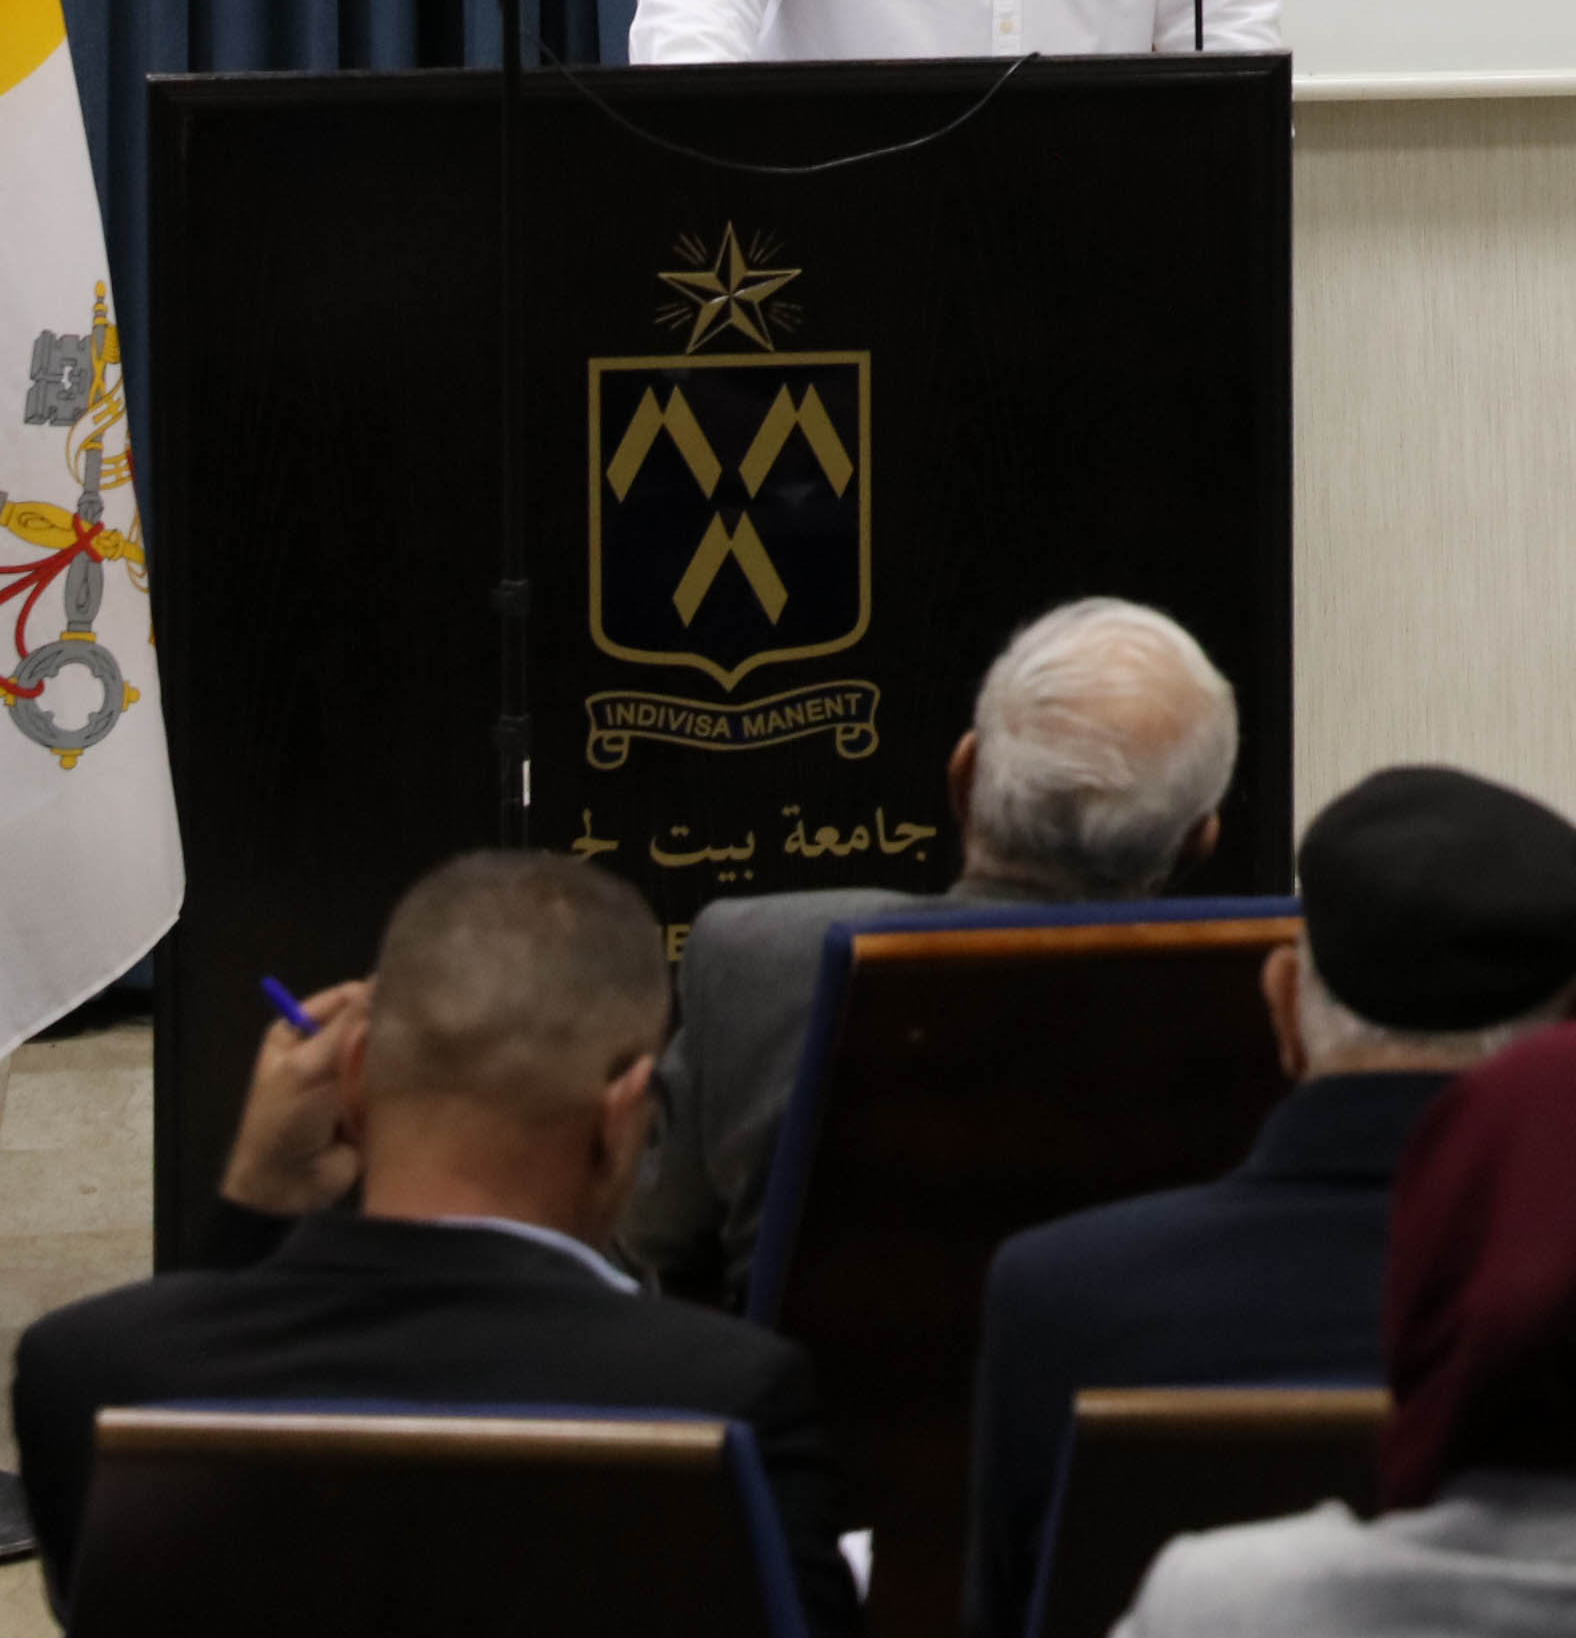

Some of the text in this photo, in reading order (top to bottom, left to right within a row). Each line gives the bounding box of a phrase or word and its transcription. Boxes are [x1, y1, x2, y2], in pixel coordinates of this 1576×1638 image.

[606, 693, 862, 738] INDIVISA MANENT
[570, 804, 937, 882] جامعة بيت لح
